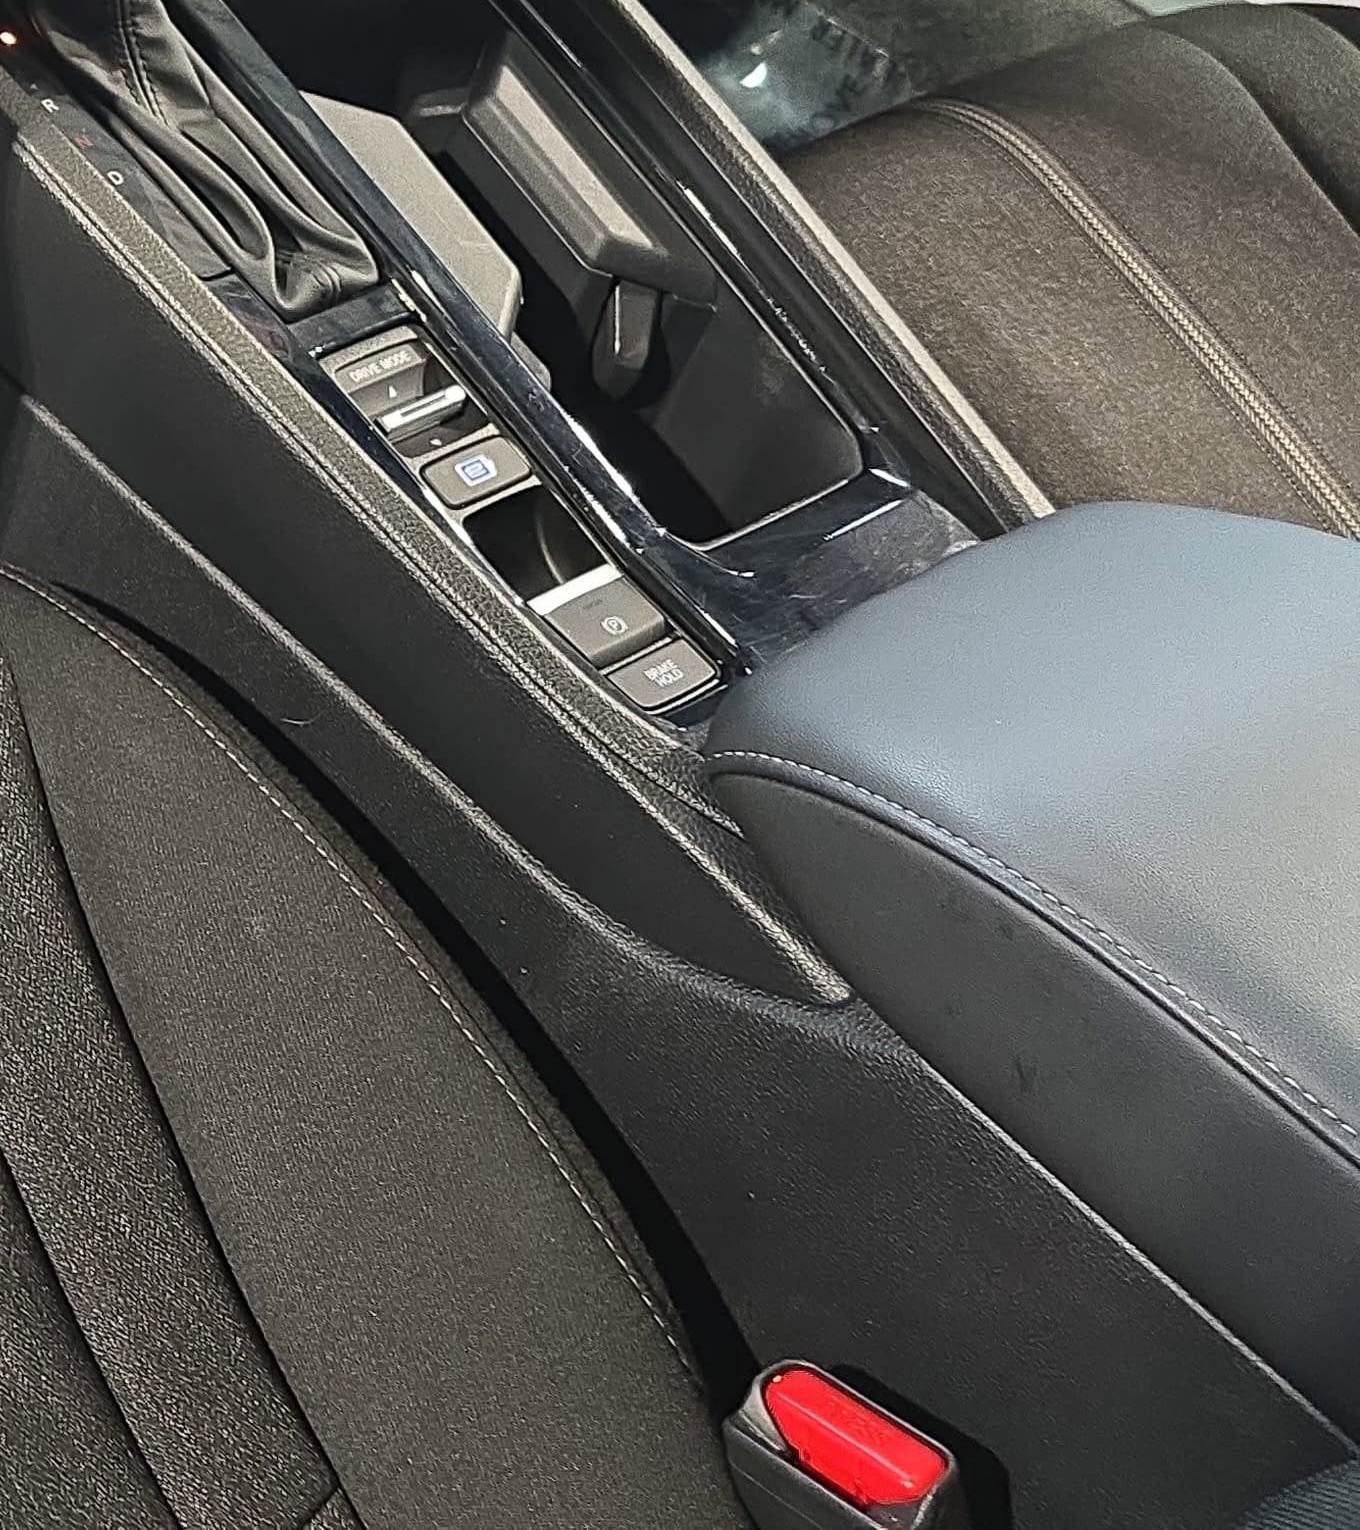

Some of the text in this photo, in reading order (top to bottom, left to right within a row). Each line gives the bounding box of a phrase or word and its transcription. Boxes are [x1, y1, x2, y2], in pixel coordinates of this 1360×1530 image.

[40, 98, 60, 114] R
[106, 170, 125, 186] D
[348, 350, 413, 383] DRIVE MODE
[643, 658, 679, 681] BRAKE
[655, 668, 685, 688] HOLD
